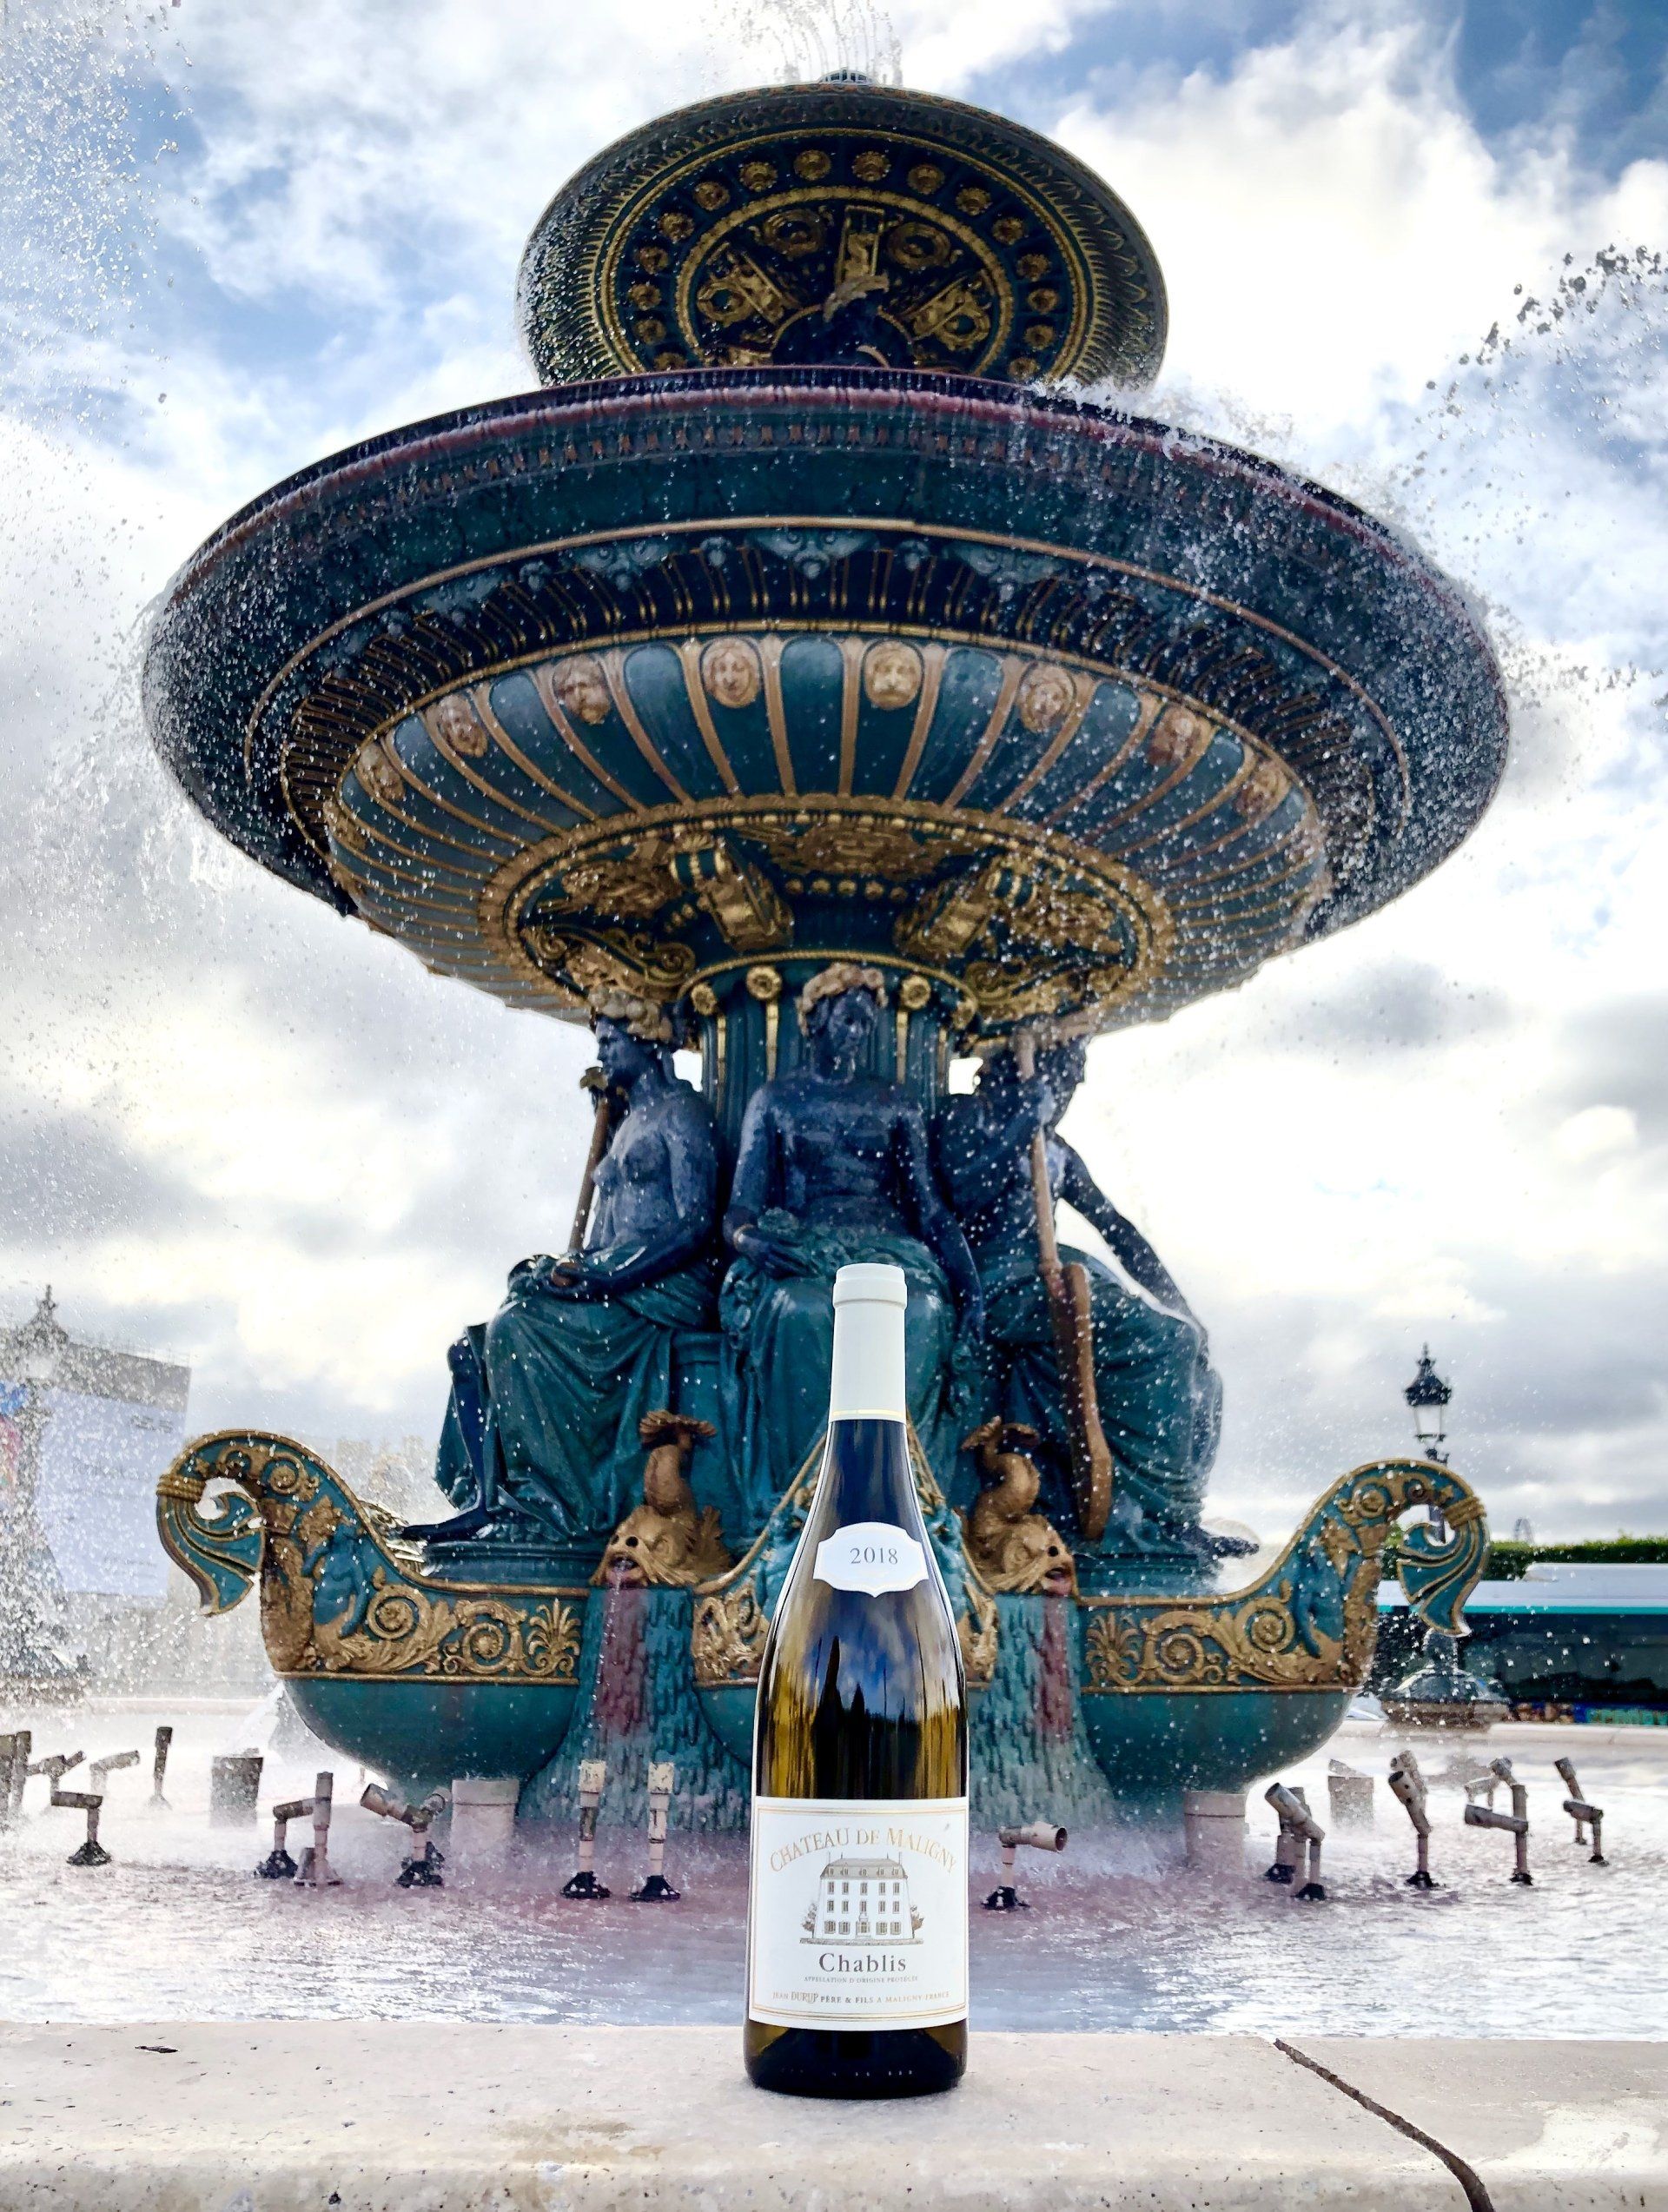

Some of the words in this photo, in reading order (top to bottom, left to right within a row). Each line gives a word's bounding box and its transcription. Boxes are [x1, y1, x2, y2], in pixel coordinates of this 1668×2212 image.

[850, 1546, 898, 1565] 2018
[771, 1827, 850, 1872] CHATEAU
[857, 1828, 880, 1845] DE
[887, 1827, 956, 1873] MALIGNY
[818, 1952, 906, 1973] Chablis
[772, 1990, 789, 2000] JEAN
[791, 1990, 819, 2004] DURUP
